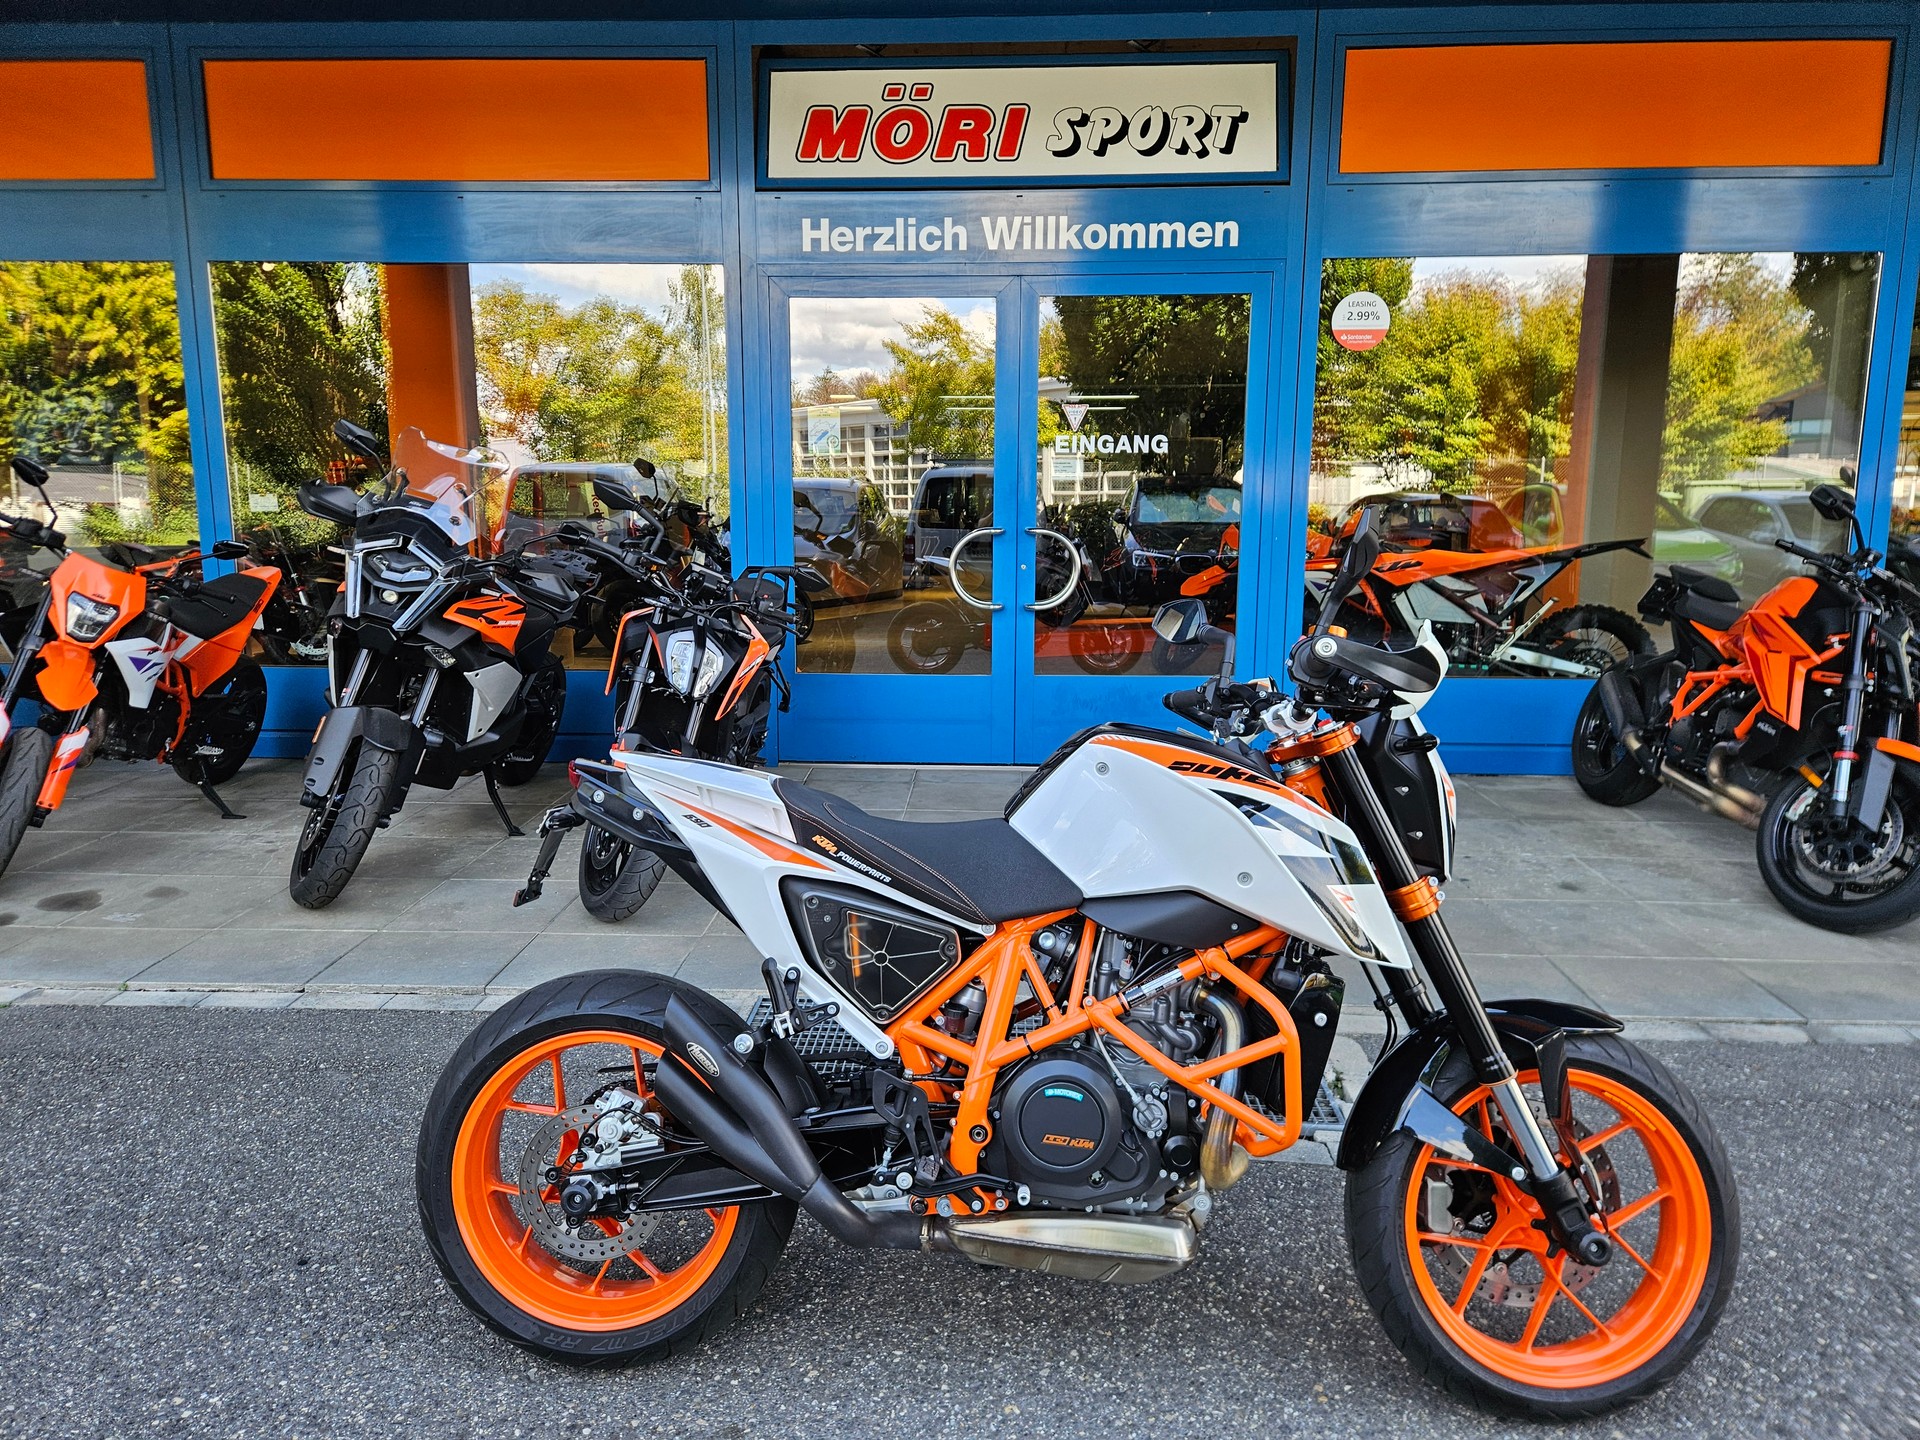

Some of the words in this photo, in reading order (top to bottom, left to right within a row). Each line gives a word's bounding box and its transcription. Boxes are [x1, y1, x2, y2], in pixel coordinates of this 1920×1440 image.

[796, 83, 1030, 164] MÖRI
[1046, 105, 1248, 158] SPORT
[801, 216, 968, 253] Herzlich
[981, 215, 1239, 251] Willkommen
[1348, 300, 1377, 308] LEASING
[1347, 310, 1380, 321] 2.99%
[1055, 434, 1169, 454] EINGANG
[1167, 760, 1281, 790] DUKE
[811, 834, 838, 854] KTM
[543, 1333, 582, 1349] RR
